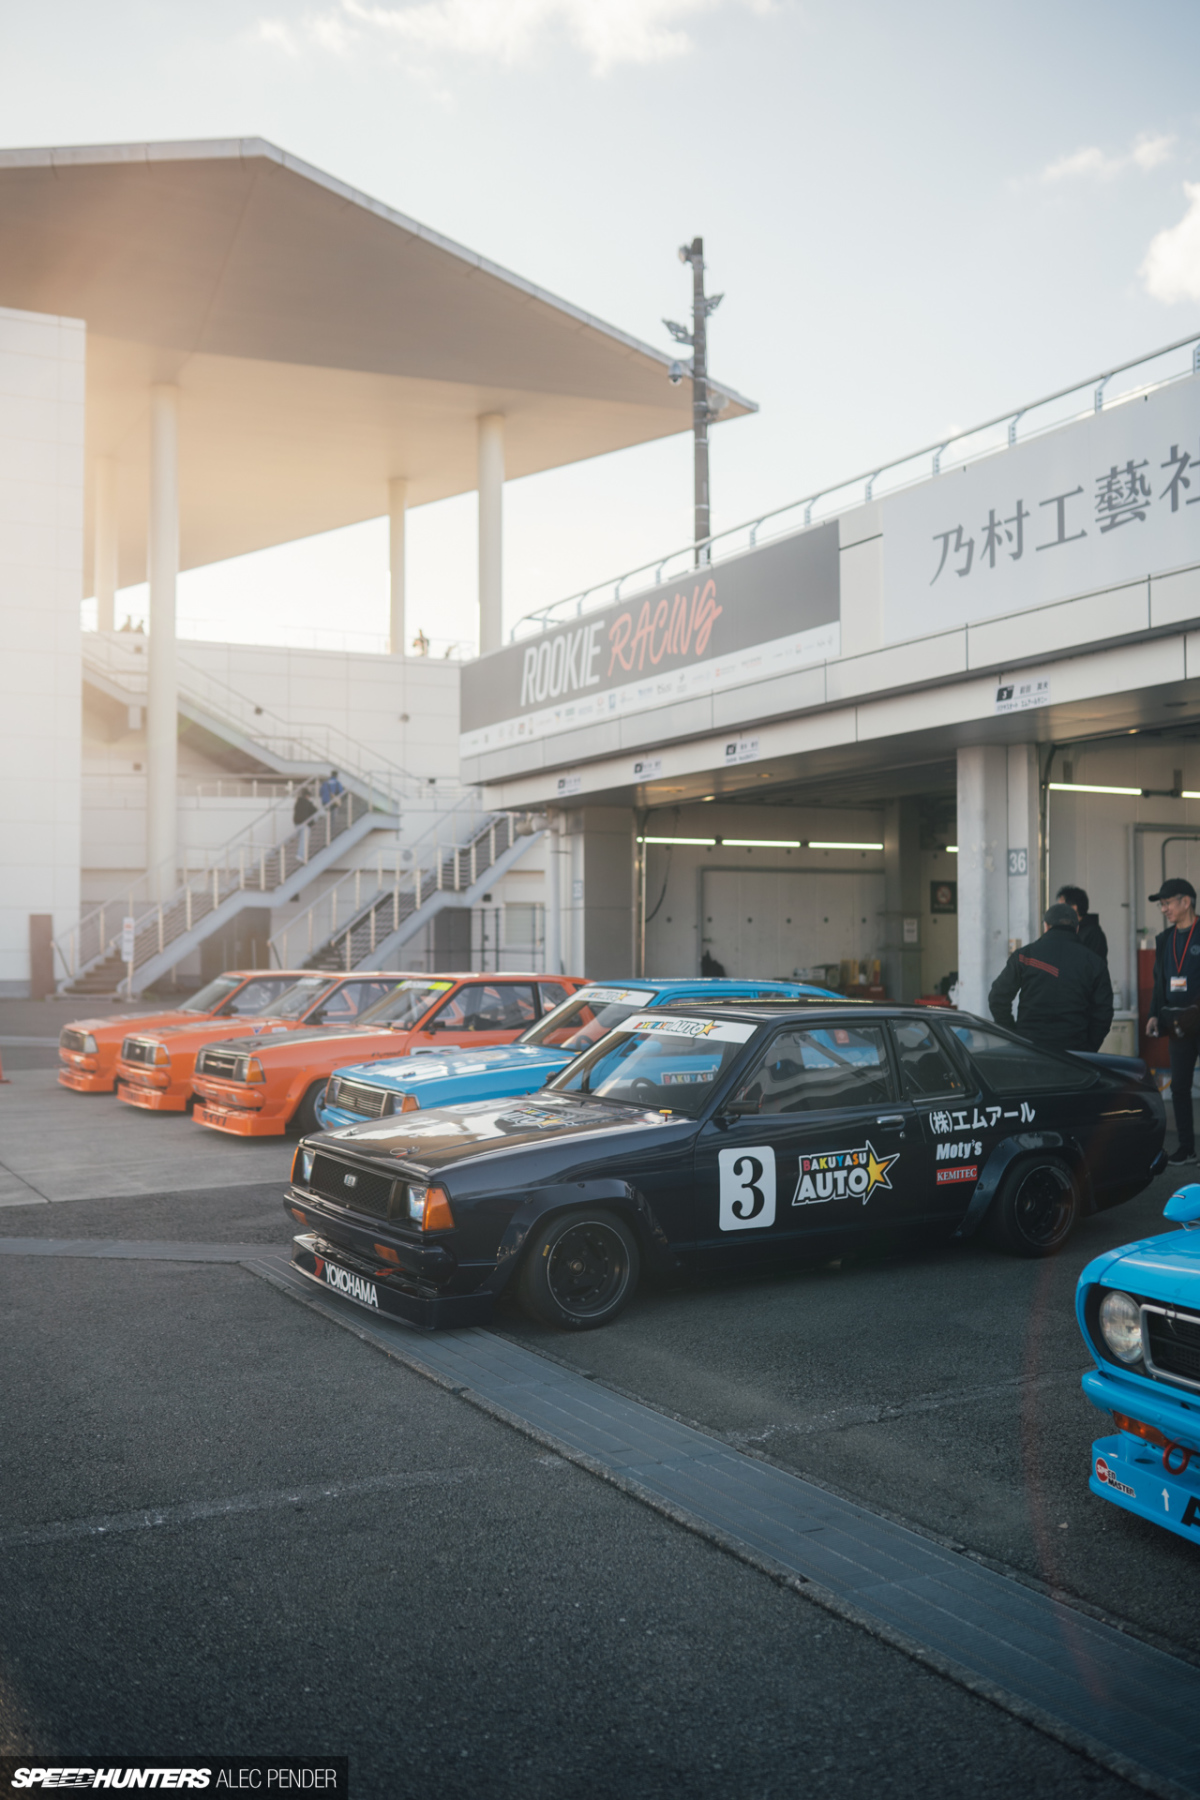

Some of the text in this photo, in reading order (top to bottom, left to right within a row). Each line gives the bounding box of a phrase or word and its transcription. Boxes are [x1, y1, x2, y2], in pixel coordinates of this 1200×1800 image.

[929, 444, 1200, 587] 乃村工藝社
[520, 578, 723, 707] ROOKIE RACING
[1009, 852, 1027, 873] 36
[669, 1020, 705, 1036] AUTO
[929, 1101, 1036, 1134] (株)エムアール
[803, 1152, 867, 1172] BAKUYASU
[936, 1139, 983, 1160] Moty's
[731, 1155, 766, 1220] 3
[797, 1167, 869, 1201] AUTO
[937, 1168, 977, 1182] KEMITEC
[324, 1262, 379, 1308] YOKOHAMA
[1108, 1477, 1135, 1497] MASTER
